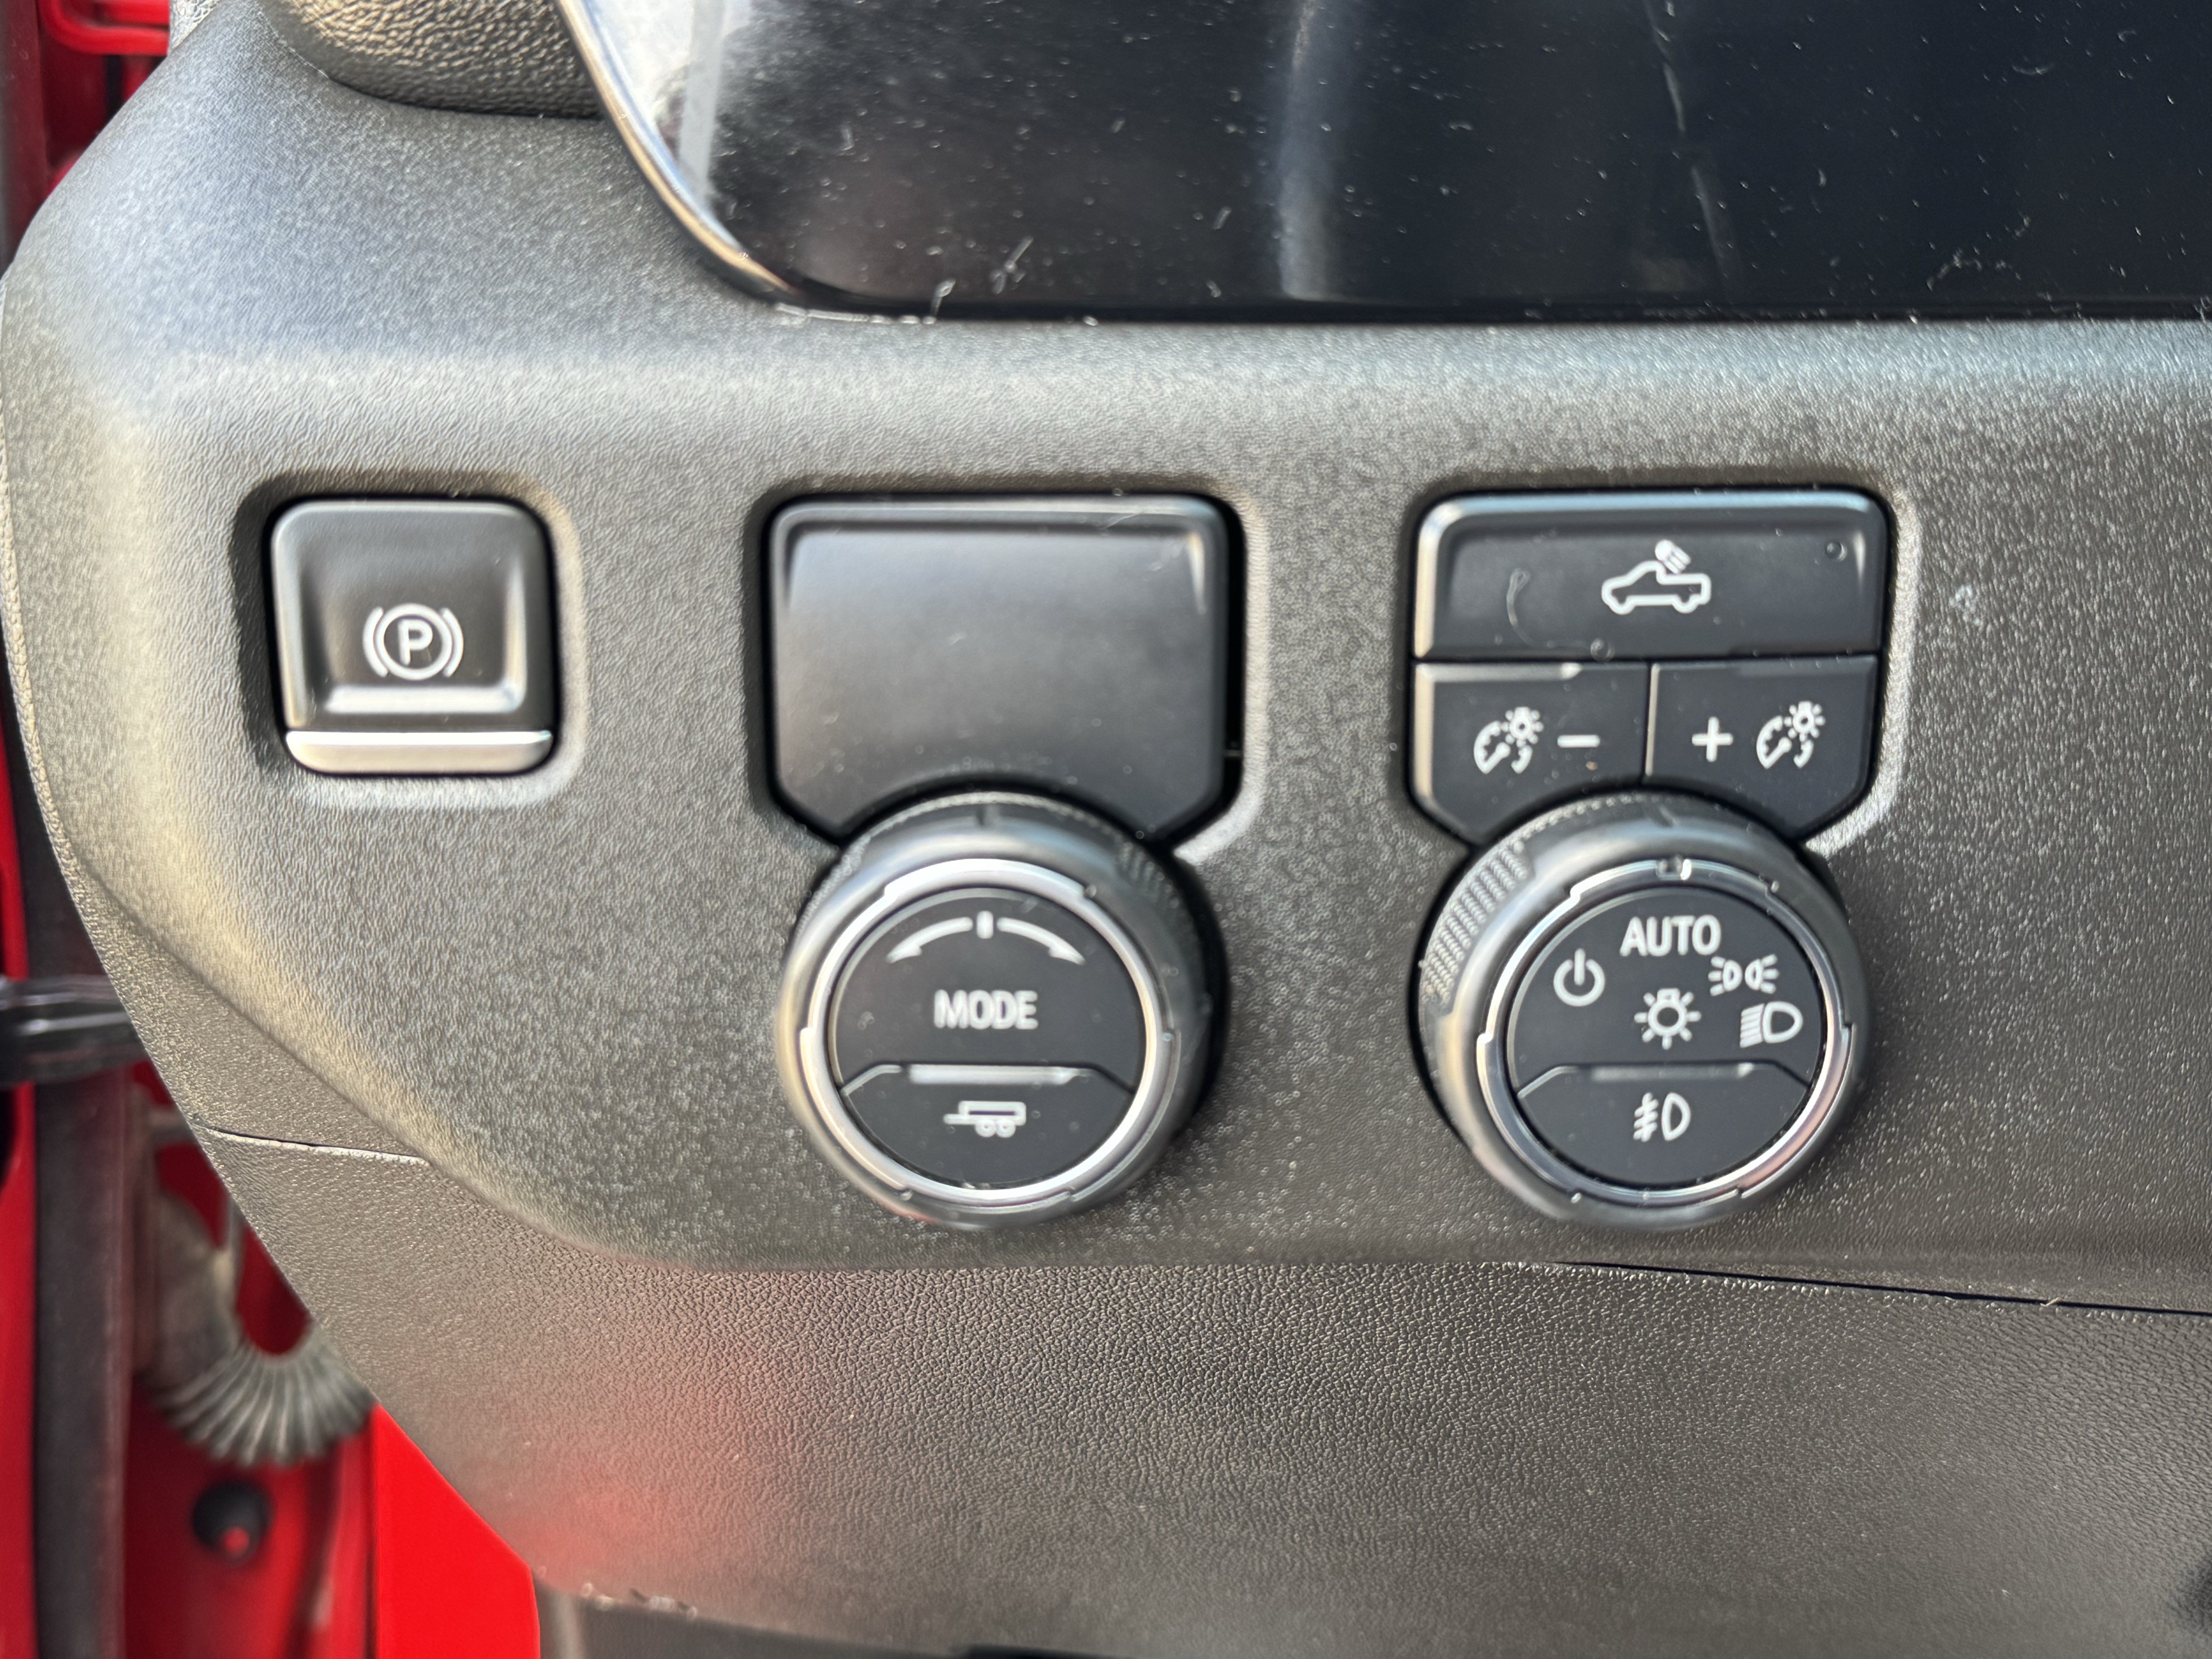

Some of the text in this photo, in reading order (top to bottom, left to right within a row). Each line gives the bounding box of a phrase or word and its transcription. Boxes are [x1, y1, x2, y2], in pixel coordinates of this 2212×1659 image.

[397, 620, 433, 665] P
[1620, 914, 1721, 957] AUTO
[933, 989, 1038, 1030] MODE
